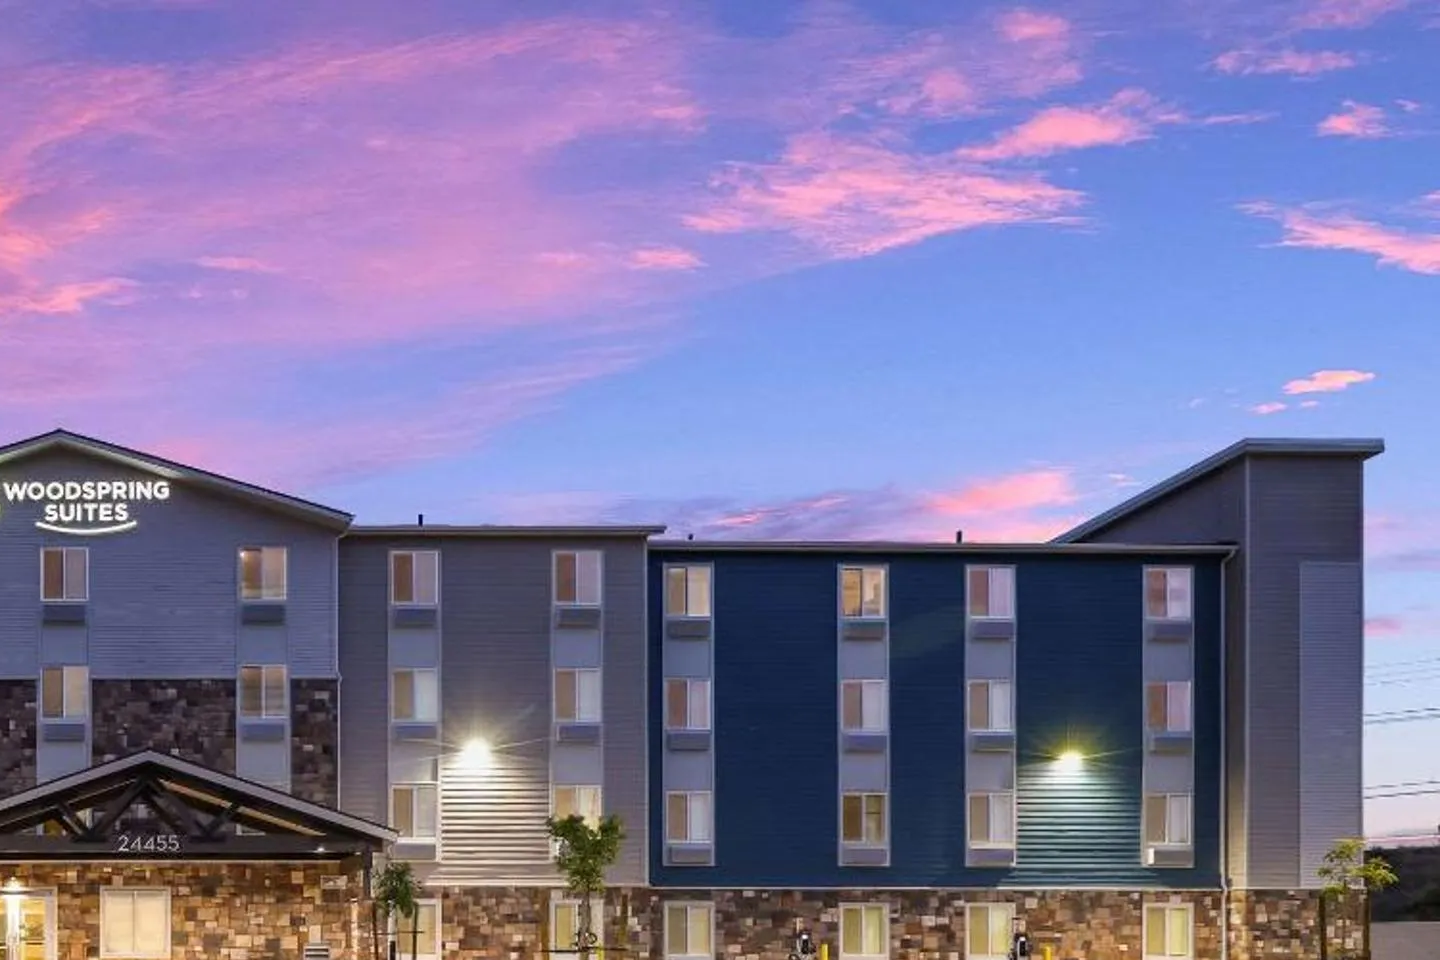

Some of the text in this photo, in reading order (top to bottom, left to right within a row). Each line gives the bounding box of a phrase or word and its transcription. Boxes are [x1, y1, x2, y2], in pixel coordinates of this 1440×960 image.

[2, 481, 170, 501] WOODSPRING
[44, 503, 129, 521] SUITES
[118, 834, 180, 851] 24455
